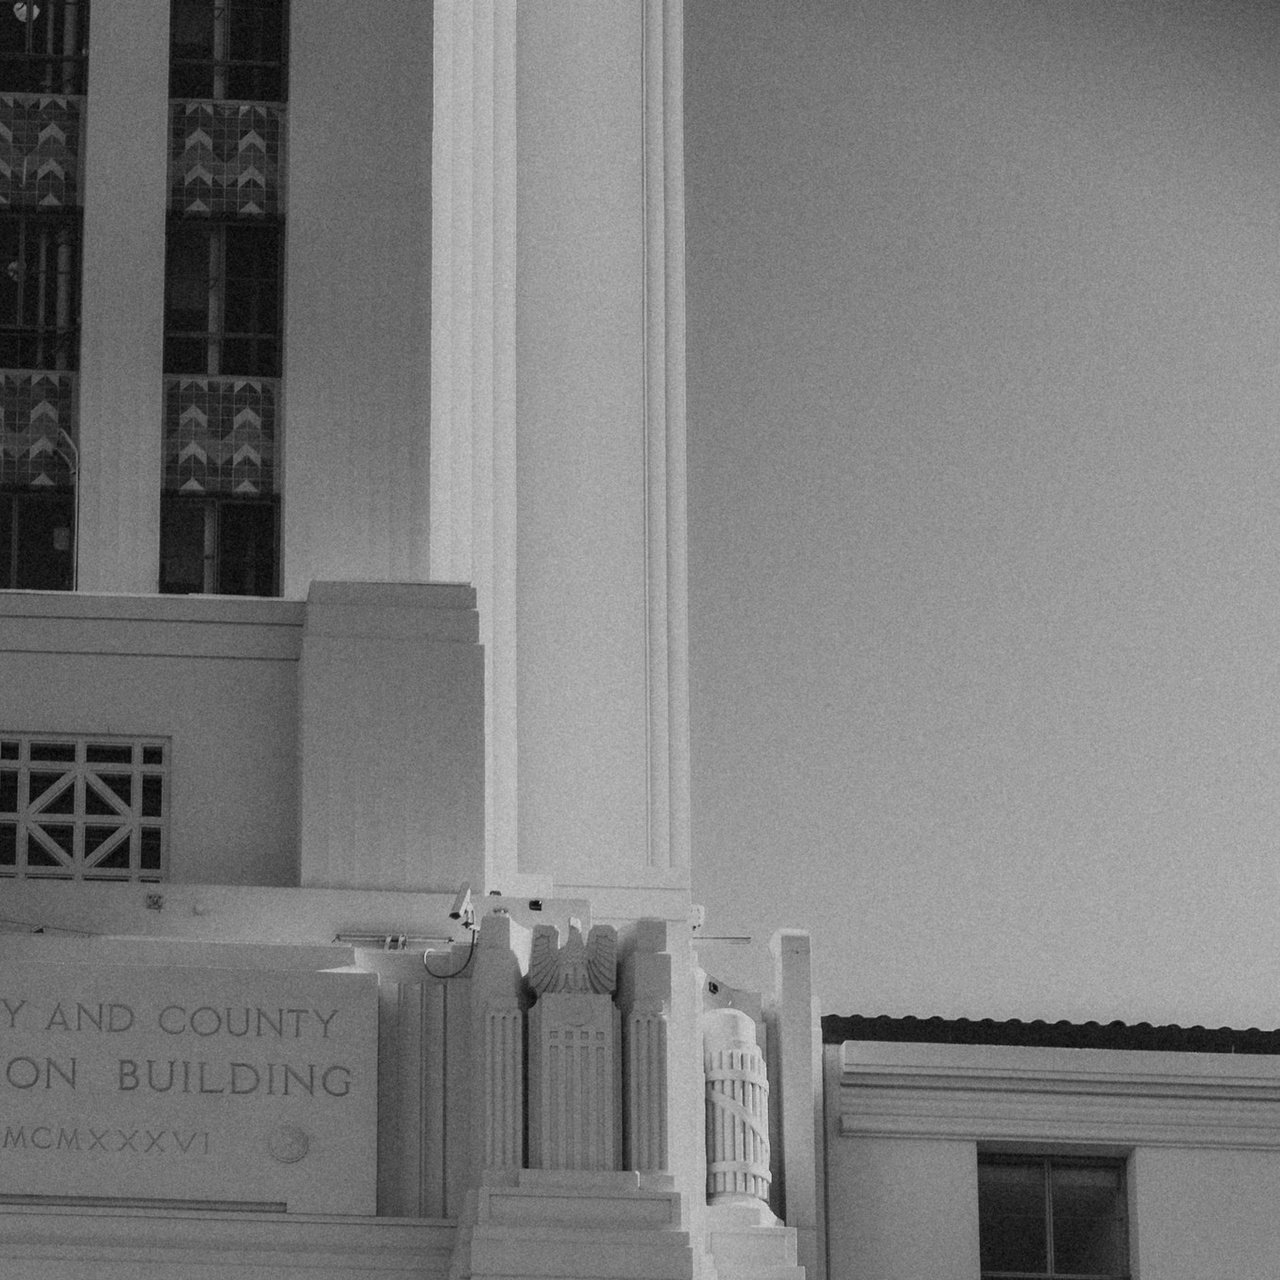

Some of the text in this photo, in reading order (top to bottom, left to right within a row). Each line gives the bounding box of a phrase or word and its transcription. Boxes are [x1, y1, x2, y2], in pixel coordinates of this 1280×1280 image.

[45, 1001, 135, 1033] AND
[158, 1005, 339, 1038] COUNTY
[117, 1058, 352, 1097] BUILDING
[2, 1125, 210, 1154] MCMXXXVI
